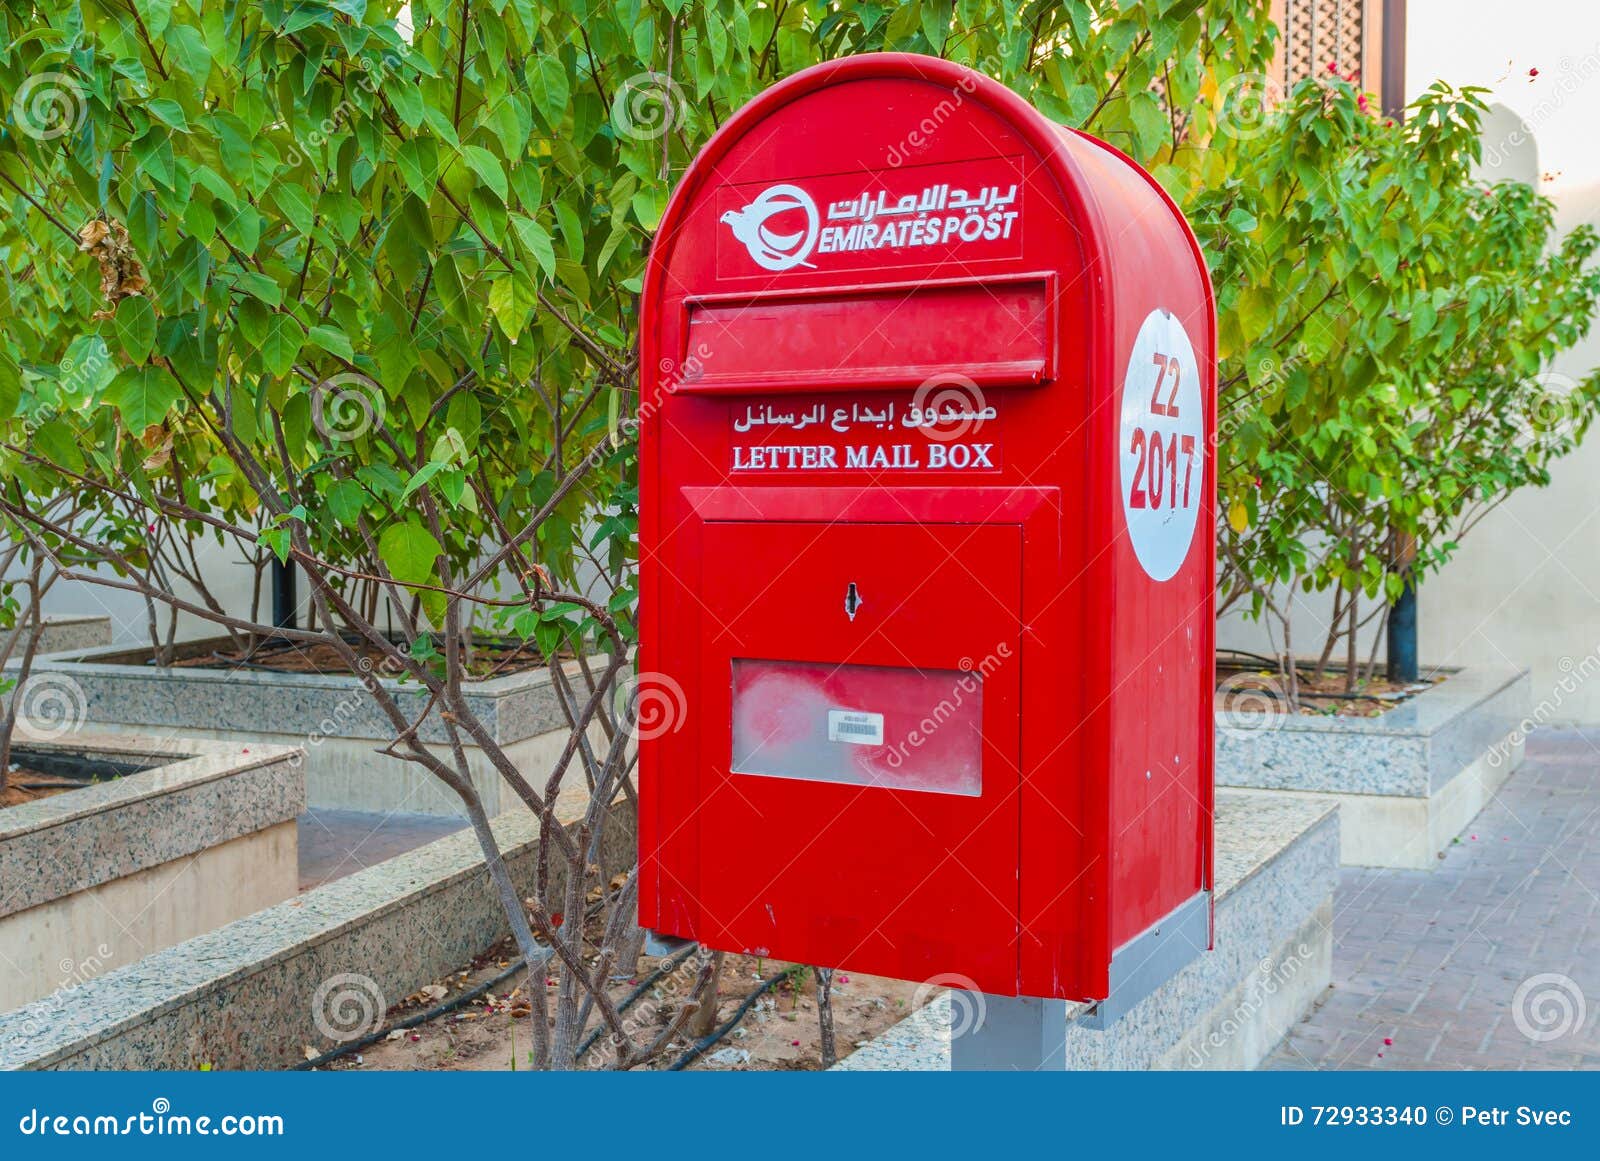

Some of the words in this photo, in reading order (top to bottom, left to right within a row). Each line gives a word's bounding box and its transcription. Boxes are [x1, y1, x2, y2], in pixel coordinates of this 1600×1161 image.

[948, 184, 1017, 211] بريد
[1150, 352, 1181, 418] Z2
[901, 402, 997, 428] صندوق
[732, 446, 839, 469] LETTER
[844, 445, 919, 469] MAIL
[927, 443, 994, 468] BOX
[1129, 427, 1195, 511] 2017
